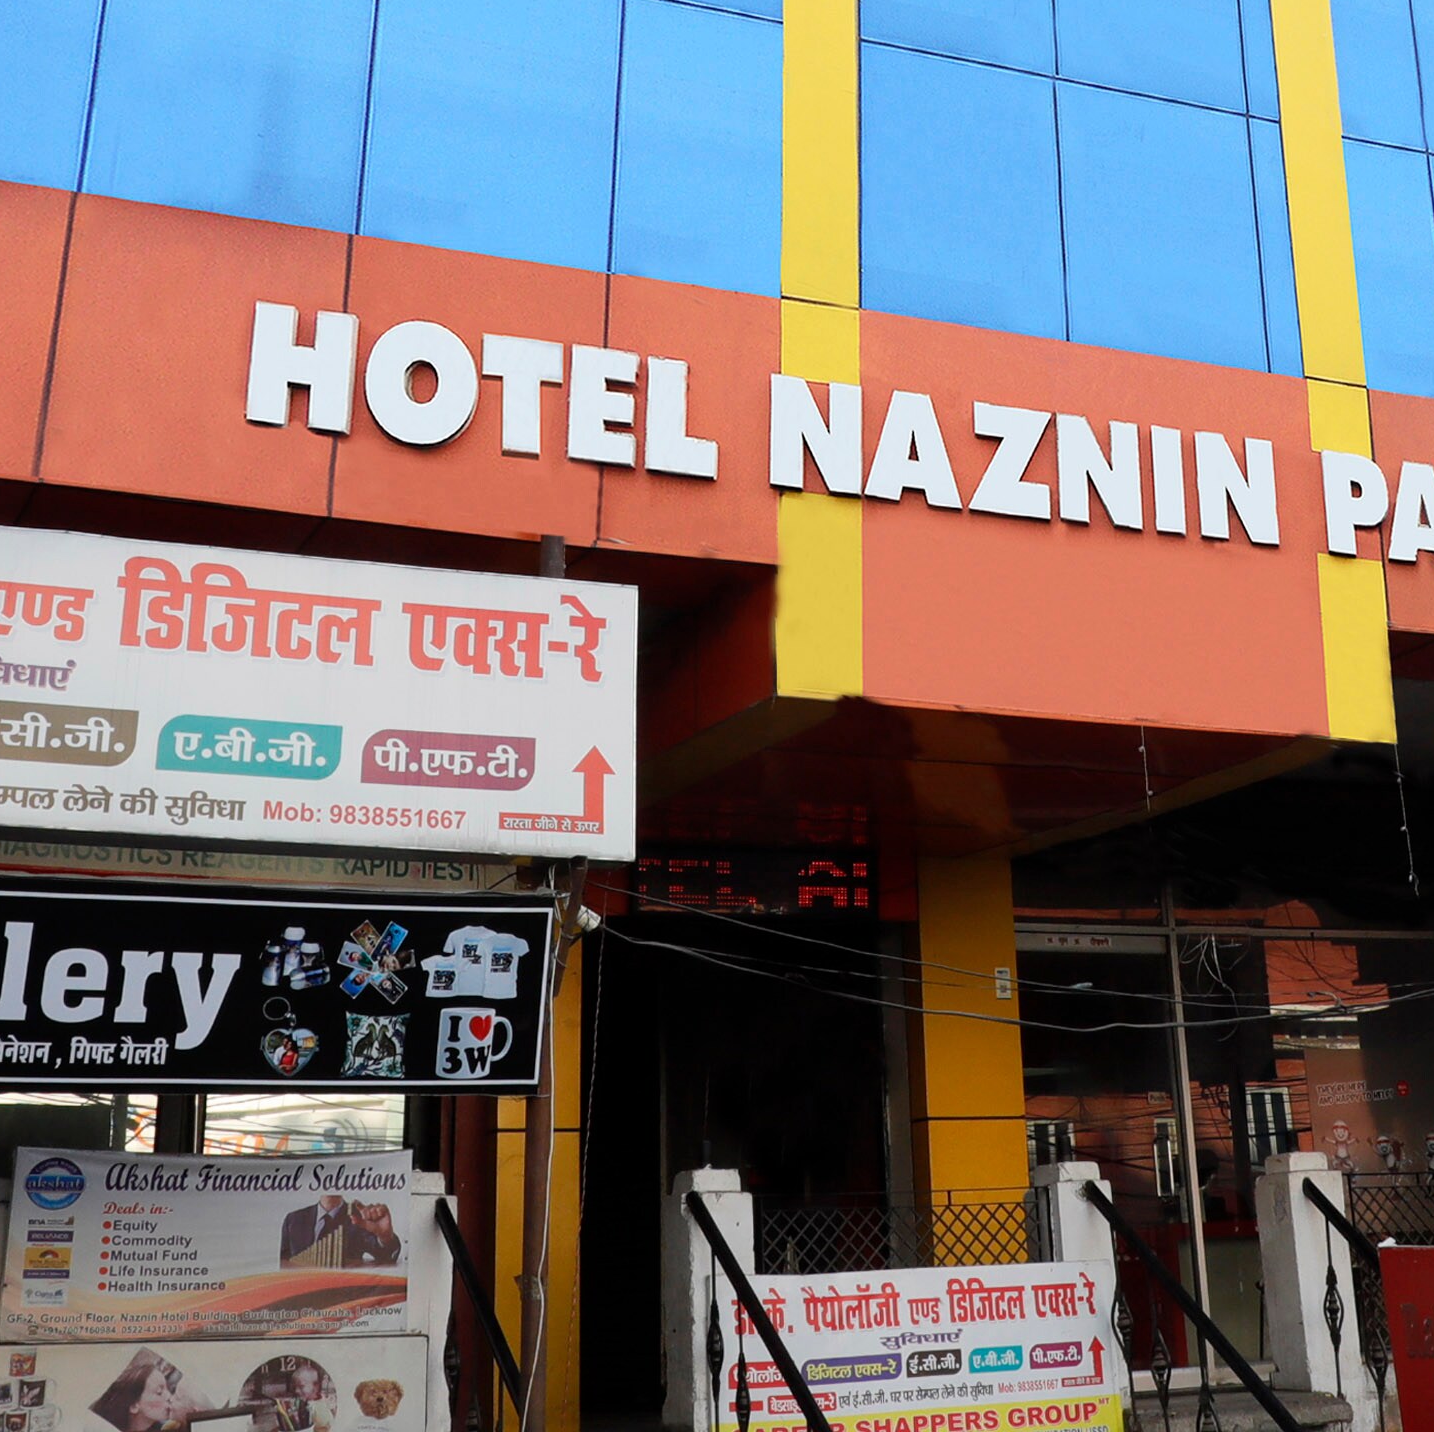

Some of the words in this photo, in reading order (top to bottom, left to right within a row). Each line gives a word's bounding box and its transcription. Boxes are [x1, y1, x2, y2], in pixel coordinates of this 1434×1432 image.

[245, 301, 719, 480] HOTEL
[768, 374, 1282, 547] NAZNIN
[117, 556, 382, 666] डिजिटल
[402, 595, 608, 682] एक्स-रे
[173, 727, 327, 767] ए.बी.जी.
[373, 738, 528, 780] पी.एफ.टी.
[62, 784, 114, 814] लेने
[120, 787, 158, 816] की
[165, 790, 246, 826] सुविधा
[263, 800, 322, 823] Mob:
[329, 805, 467, 830] 9838551667
[574, 820, 601, 834] ऊपर
[69, 1036, 116, 1065] गिफ्ट
[120, 1036, 169, 1066] गैलरी
[105, 1162, 189, 1192] Akshat
[196, 1163, 304, 1192] Financial
[309, 1163, 407, 1192] Solutions
[103, 1201, 145, 1215] Deals
[113, 1220, 158, 1233] Equity
[112, 1235, 193, 1249] Commodity
[110, 1250, 158, 1261] Mutual
[162, 1250, 198, 1261] Fund
[109, 1265, 135, 1277] Life
[140, 1265, 209, 1277] Insurance
[108, 1280, 153, 1292] Health
[158, 1279, 226, 1292] Insurance
[801, 1282, 900, 1333] पैथोलॉजी
[907, 1297, 941, 1325] एण्ड
[946, 1278, 1026, 1323] डिजिटल
[1031, 1272, 1096, 1318] एक्स-रे
[40, 1313, 82, 1324] Ground
[120, 1313, 158, 1323] Naznin
[161, 1311, 189, 1322] Hotel
[357, 1307, 403, 1318] Lucknow
[807, 1364, 852, 1381] डिजिटल
[855, 1359, 897, 1378] एक्स-रे
[1008, 1402, 1098, 1429] GROUP
